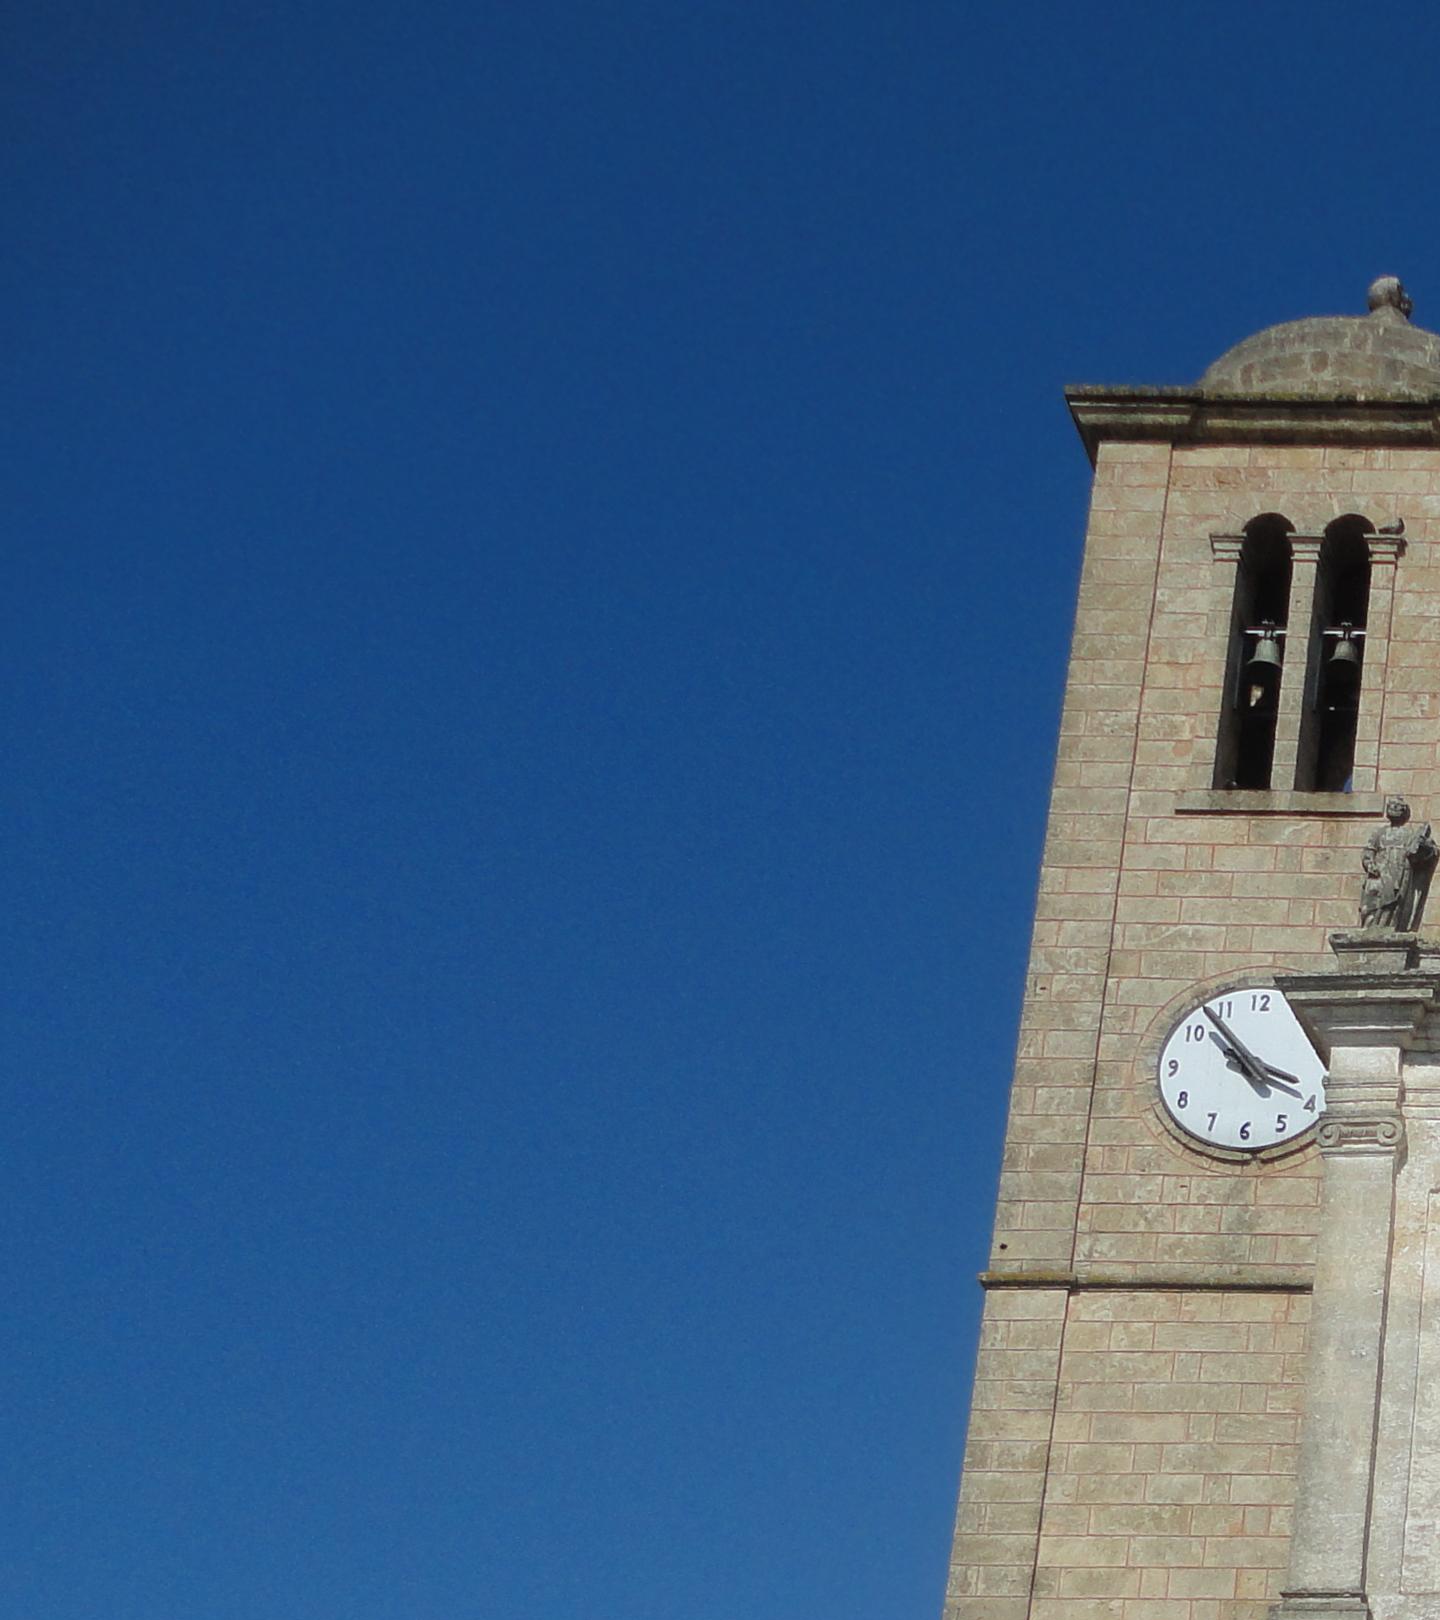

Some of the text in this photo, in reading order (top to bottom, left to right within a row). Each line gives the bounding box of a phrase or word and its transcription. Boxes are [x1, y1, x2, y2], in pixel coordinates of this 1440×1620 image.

[1218, 1001, 1234, 1020] 11
[1251, 995, 1271, 1012] 12
[1185, 1025, 1204, 1042] 10
[1168, 1060, 1179, 1077] 9
[1177, 1091, 1189, 1109] 8
[1303, 1094, 1316, 1113] 4
[1207, 1113, 1218, 1131] 7
[1240, 1122, 1250, 1140] 6
[1275, 1115, 1288, 1133] 5
